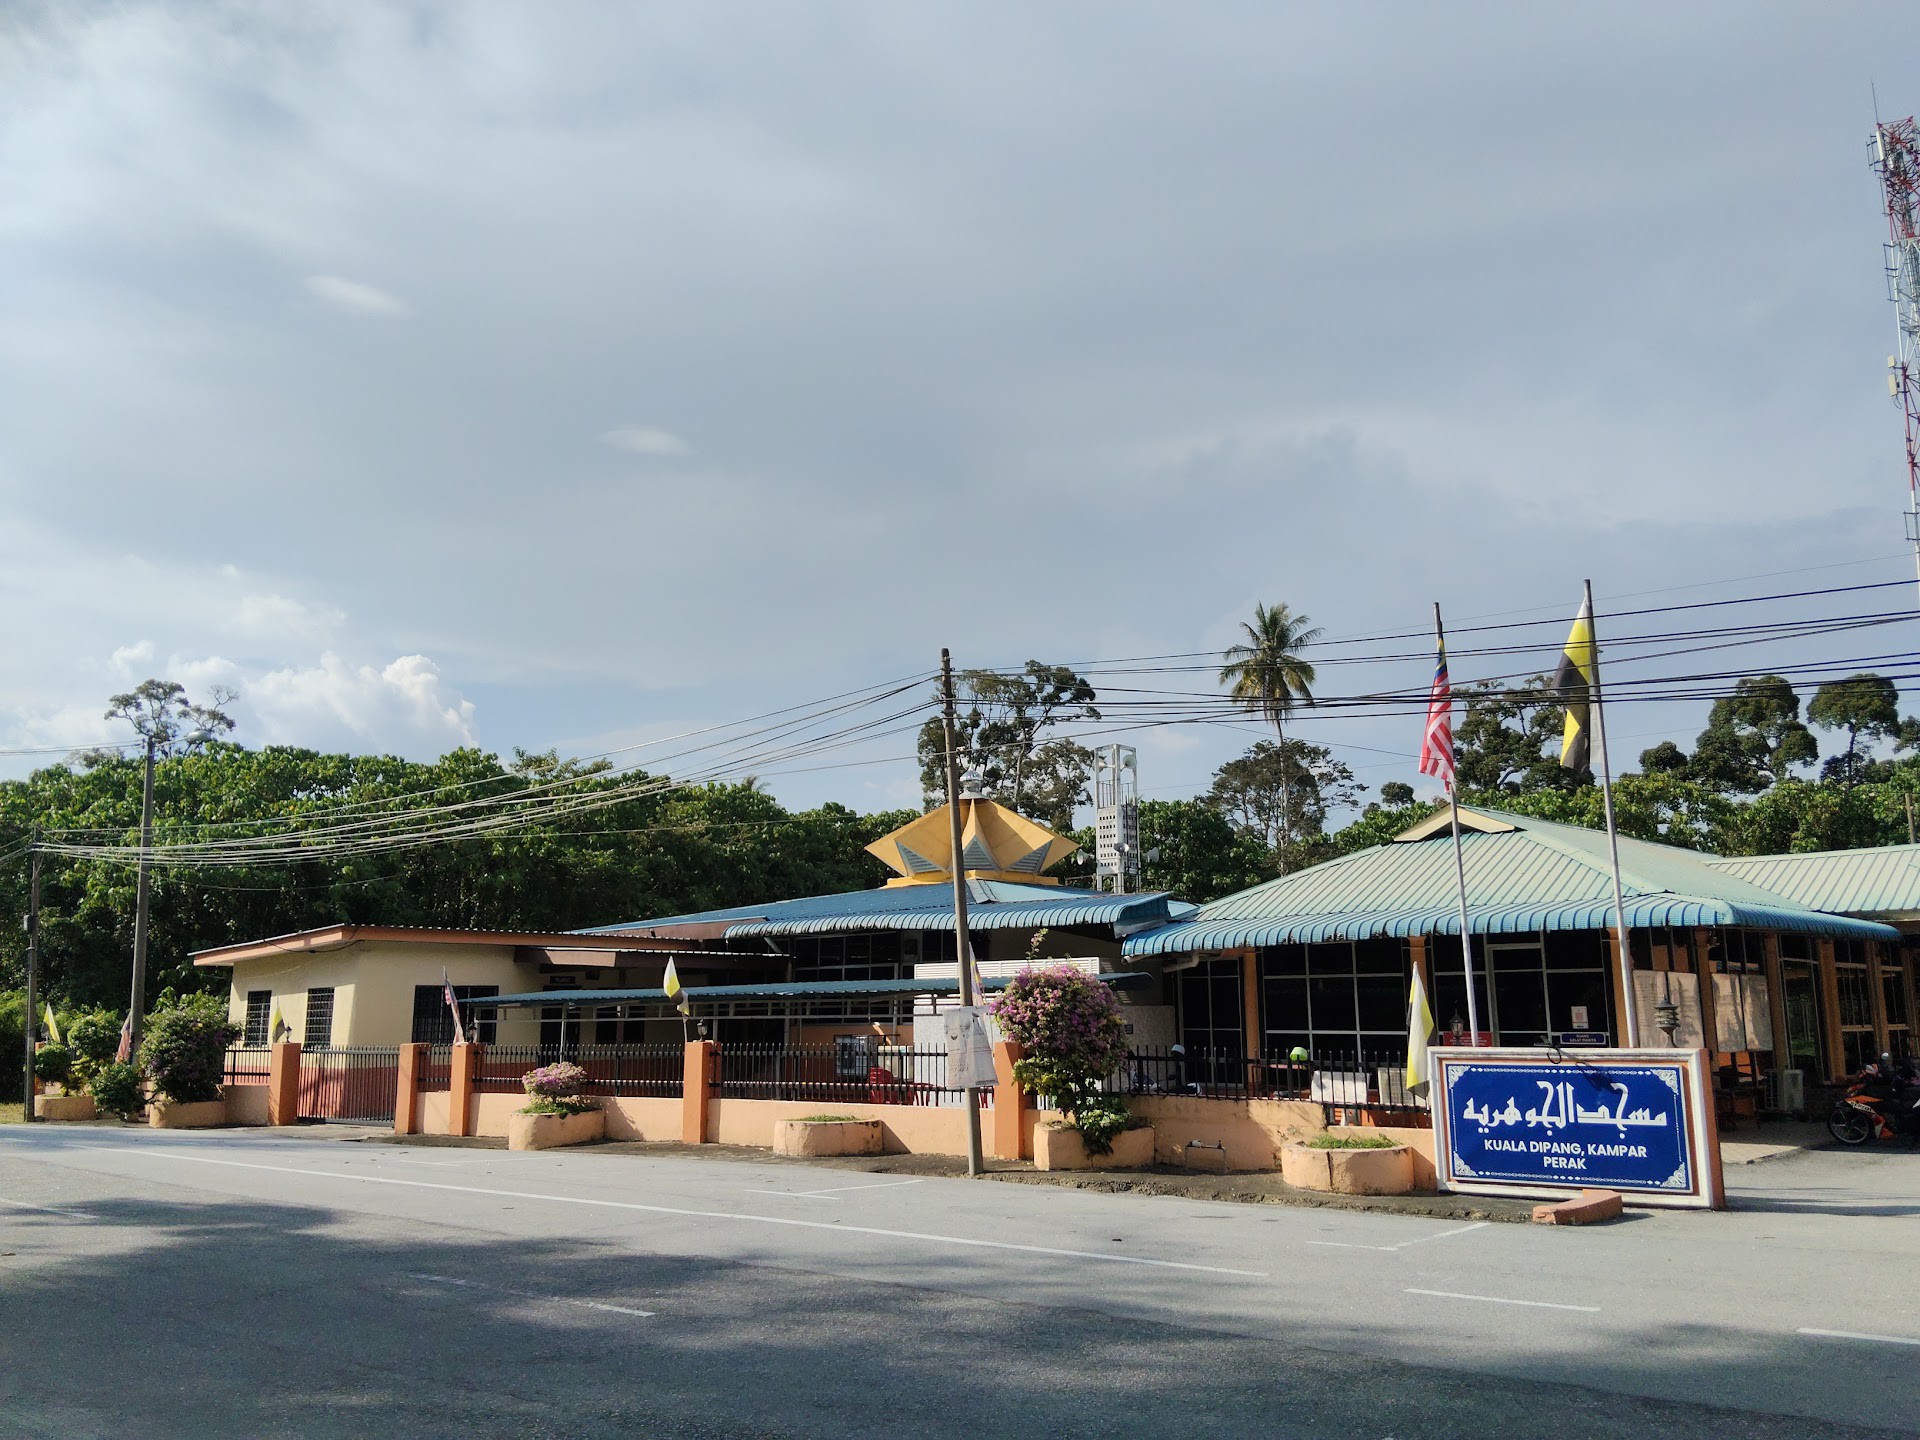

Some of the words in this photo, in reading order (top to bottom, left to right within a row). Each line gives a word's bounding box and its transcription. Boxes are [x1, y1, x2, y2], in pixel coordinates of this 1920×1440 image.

[1576, 1082, 1667, 1139] مسجد
[1484, 1139, 1527, 1152] KUALA
[1529, 1141, 1585, 1156] DIPANG,
[1587, 1143, 1648, 1158] KAMPAR
[1543, 1156, 1587, 1170] PERAK
